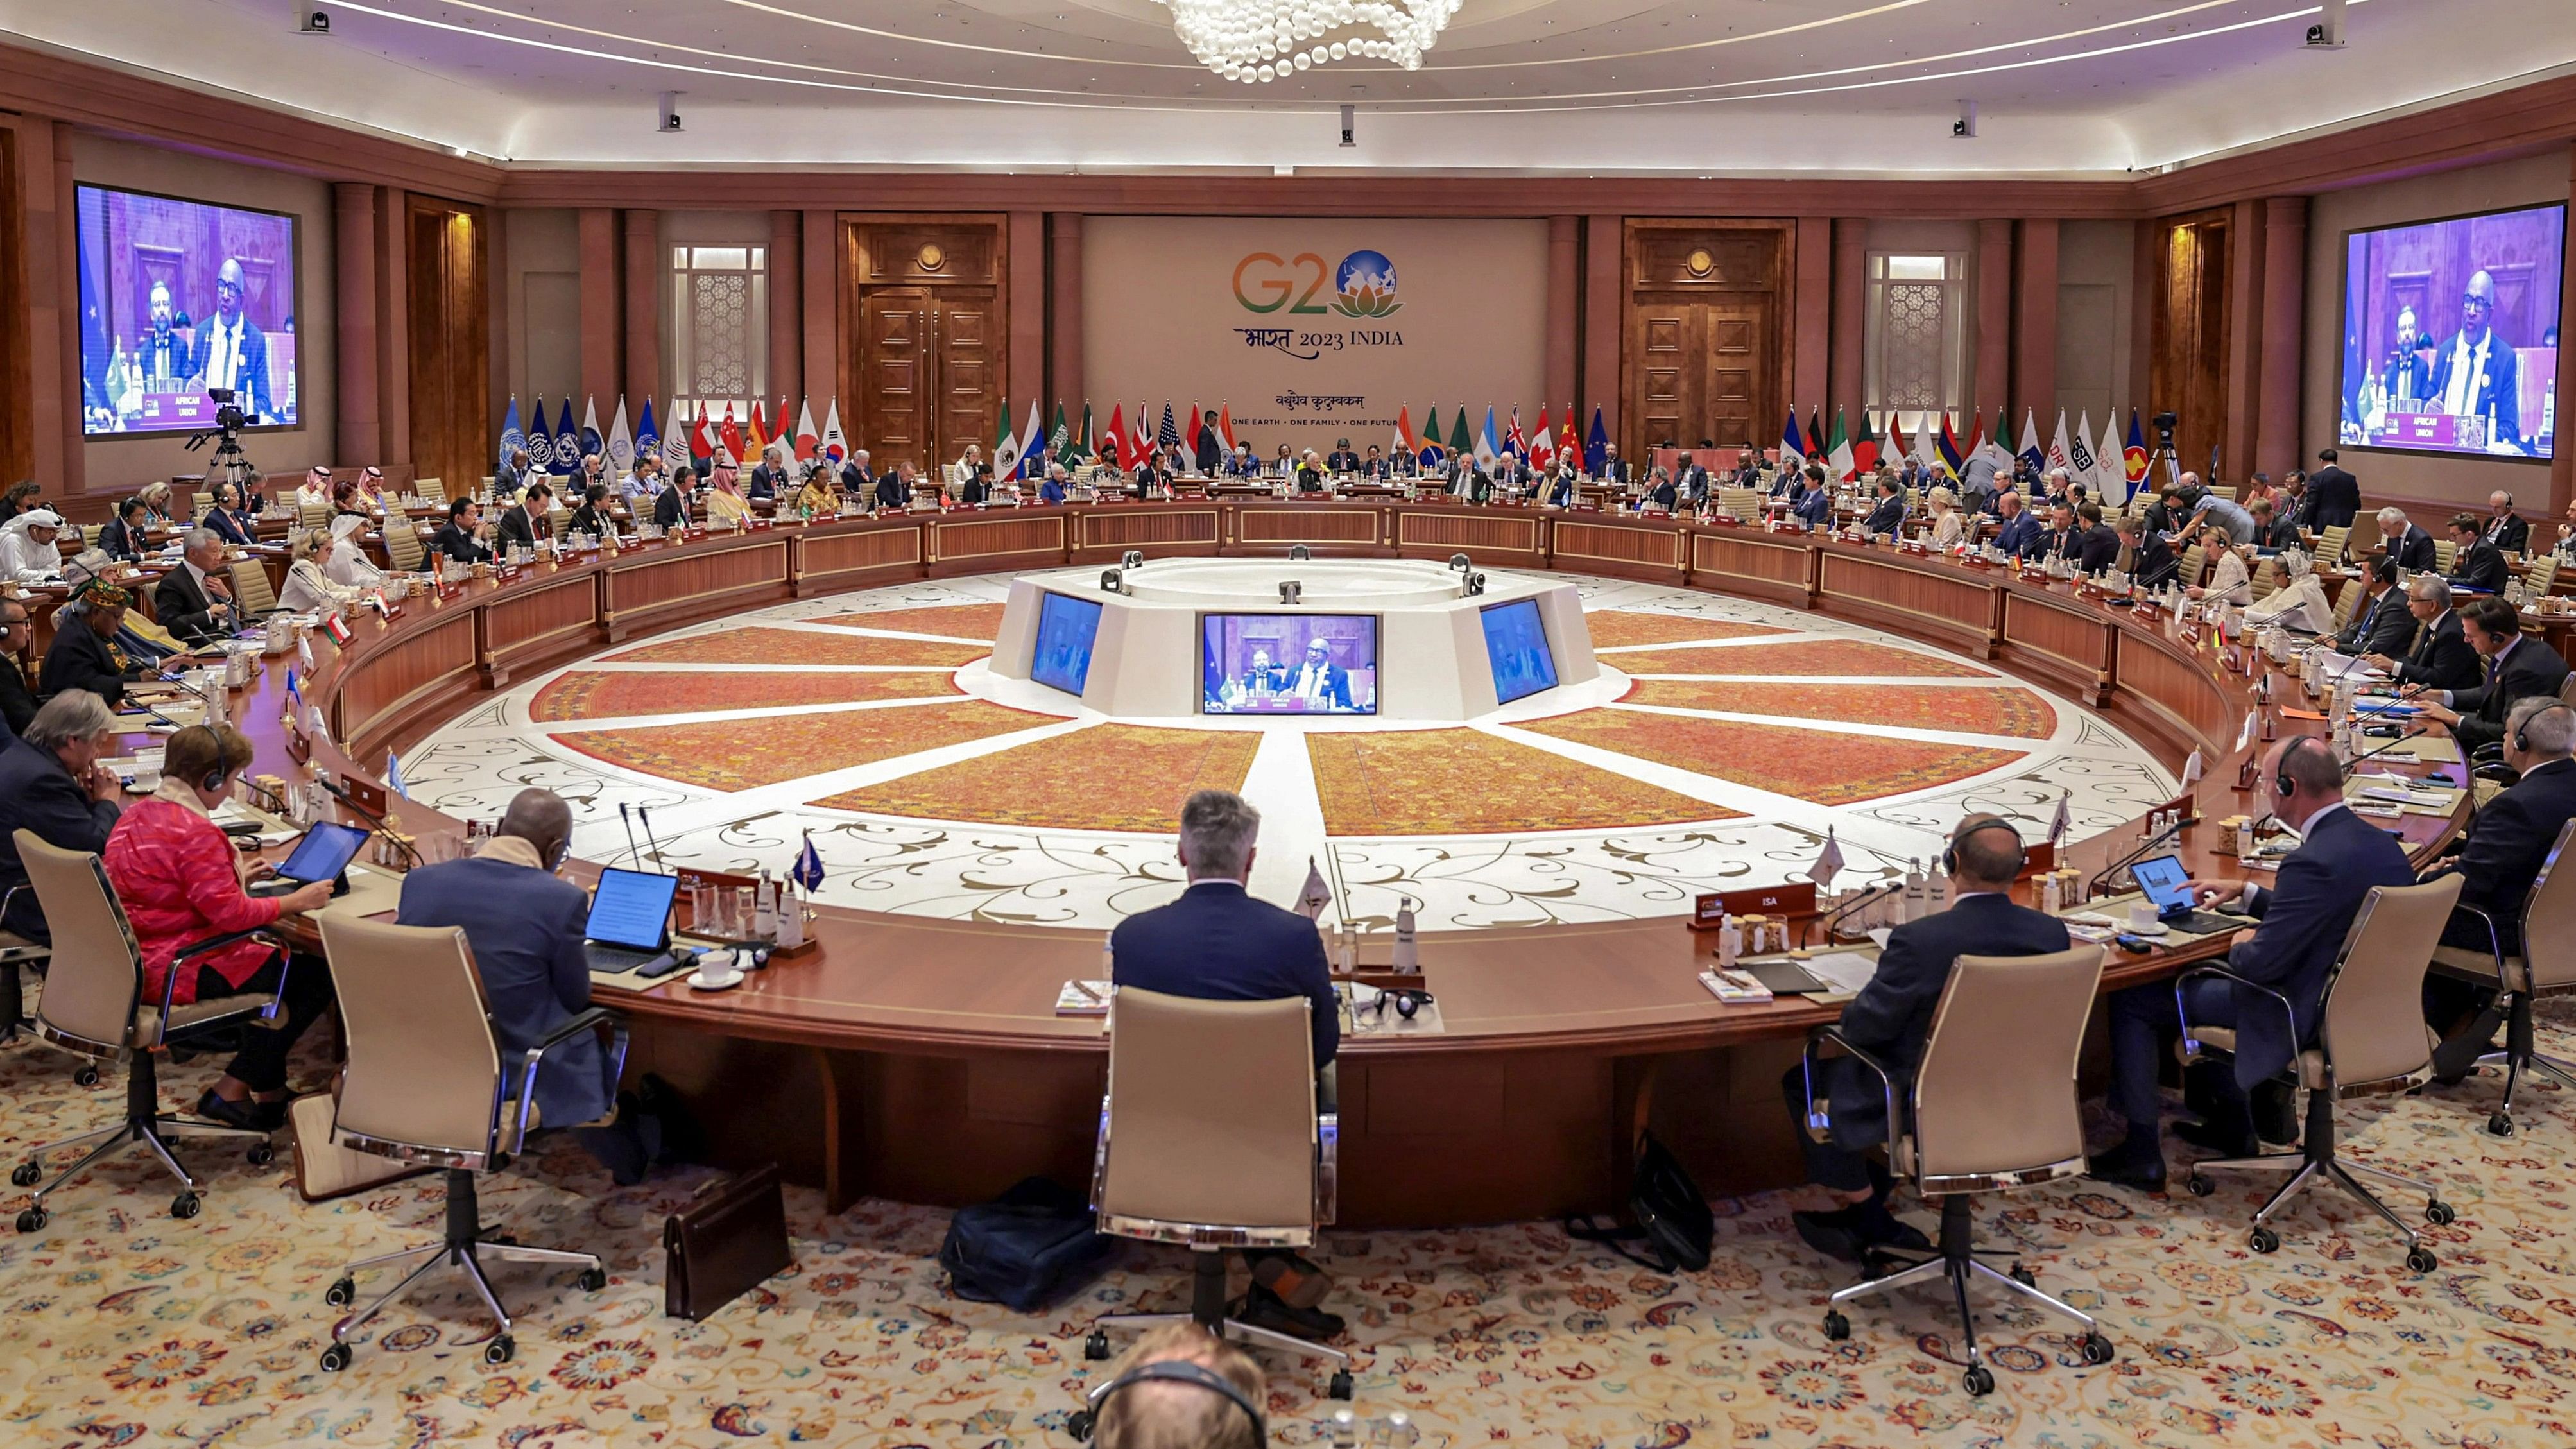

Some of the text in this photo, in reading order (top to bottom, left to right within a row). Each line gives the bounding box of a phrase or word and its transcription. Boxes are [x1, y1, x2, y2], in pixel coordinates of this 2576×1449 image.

[1233, 329, 1319, 360] भारत
[1300, 331, 1404, 350] 2023 INDIA
[2074, 439, 2090, 469] FSB
[1762, 897, 1778, 906] ISA
